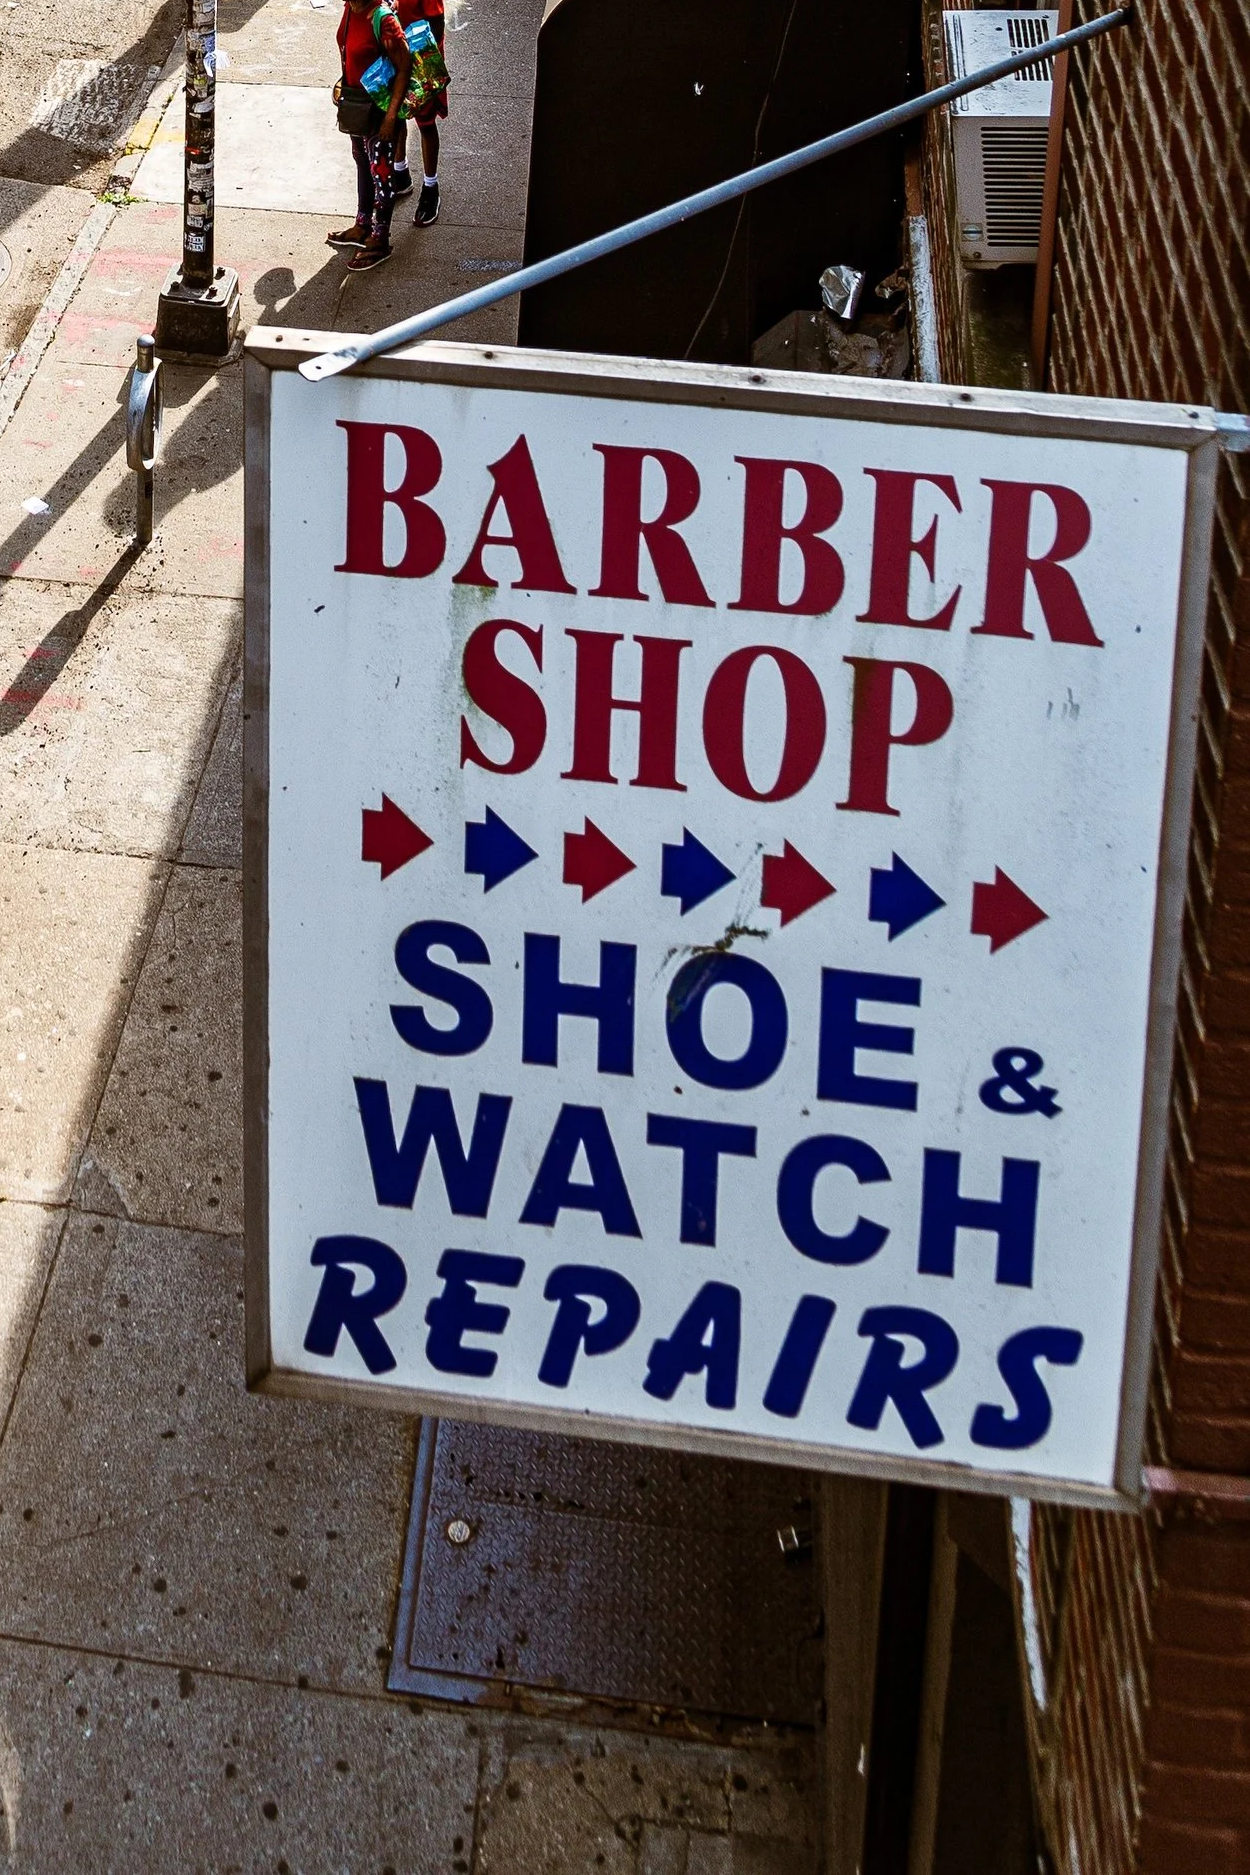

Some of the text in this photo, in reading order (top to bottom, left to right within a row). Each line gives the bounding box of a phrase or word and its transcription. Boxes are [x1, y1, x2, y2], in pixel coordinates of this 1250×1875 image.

[334, 419, 1105, 648] BARBER
[458, 618, 954, 816] SHOP
[389, 919, 1062, 1119] SHOE &
[353, 1076, 1039, 1288] WATCH
[302, 1234, 1083, 1450] REPAIRS
